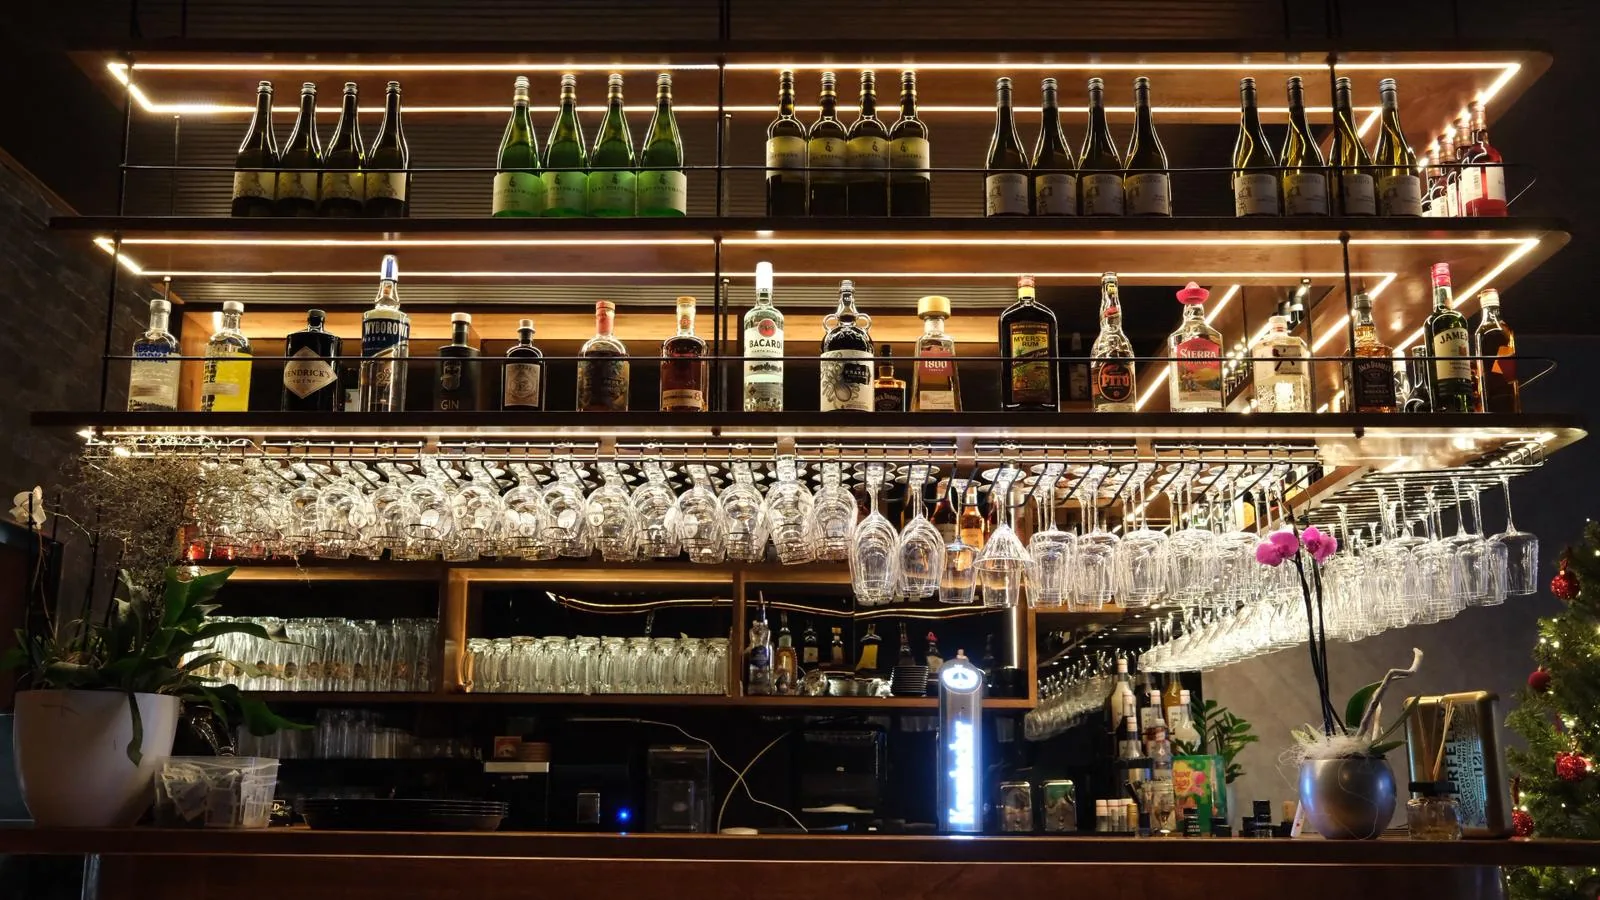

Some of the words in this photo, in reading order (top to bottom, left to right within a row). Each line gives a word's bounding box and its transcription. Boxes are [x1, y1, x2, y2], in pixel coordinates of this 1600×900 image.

[749, 338, 783, 349] BACARDI
[1180, 348, 1217, 358] SIERRA
[924, 360, 947, 369] 1800
[440, 400, 459, 410] GIN
[1472, 755, 1483, 773] 12
